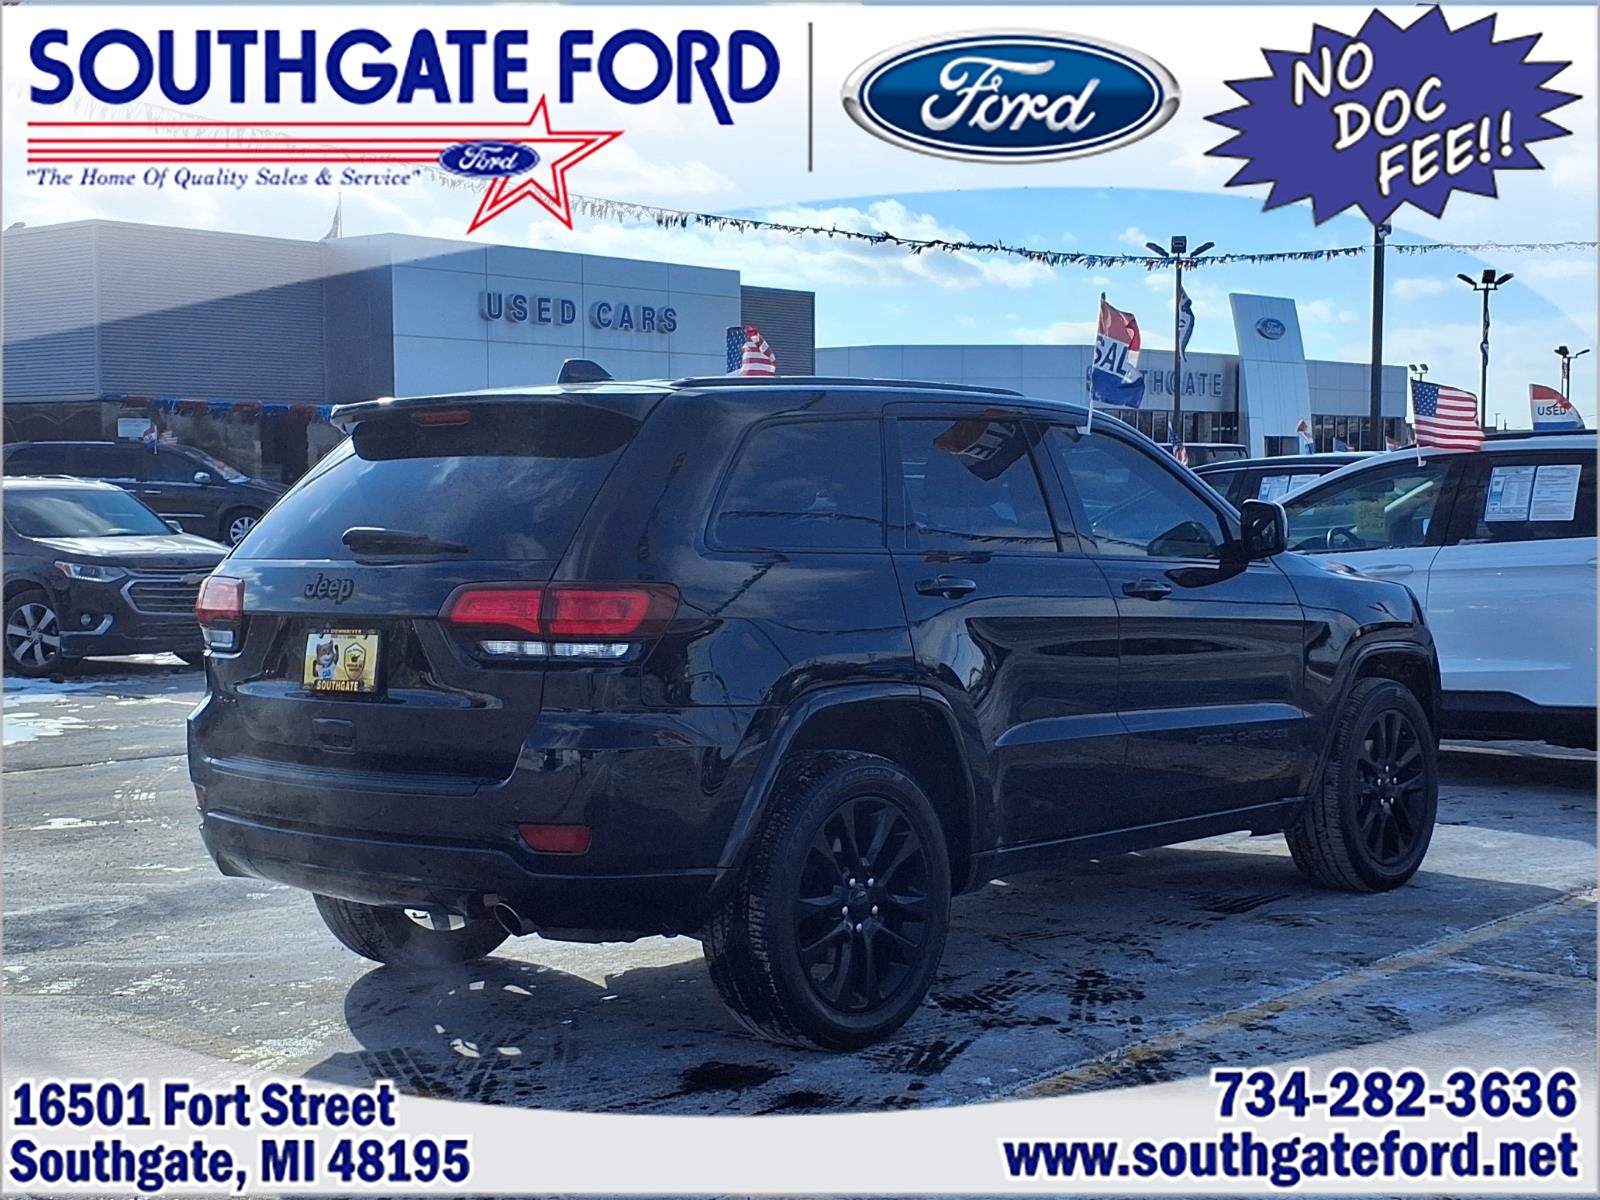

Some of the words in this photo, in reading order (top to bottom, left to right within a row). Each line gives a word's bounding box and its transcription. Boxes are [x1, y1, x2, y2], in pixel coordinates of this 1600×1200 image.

[481, 291, 577, 326] USED
[589, 300, 679, 334] CARS
[1094, 335, 1131, 377] SAL
[1537, 405, 1567, 416] USED
[304, 573, 355, 604] Jeep
[316, 680, 359, 692] SOUTHGATE
